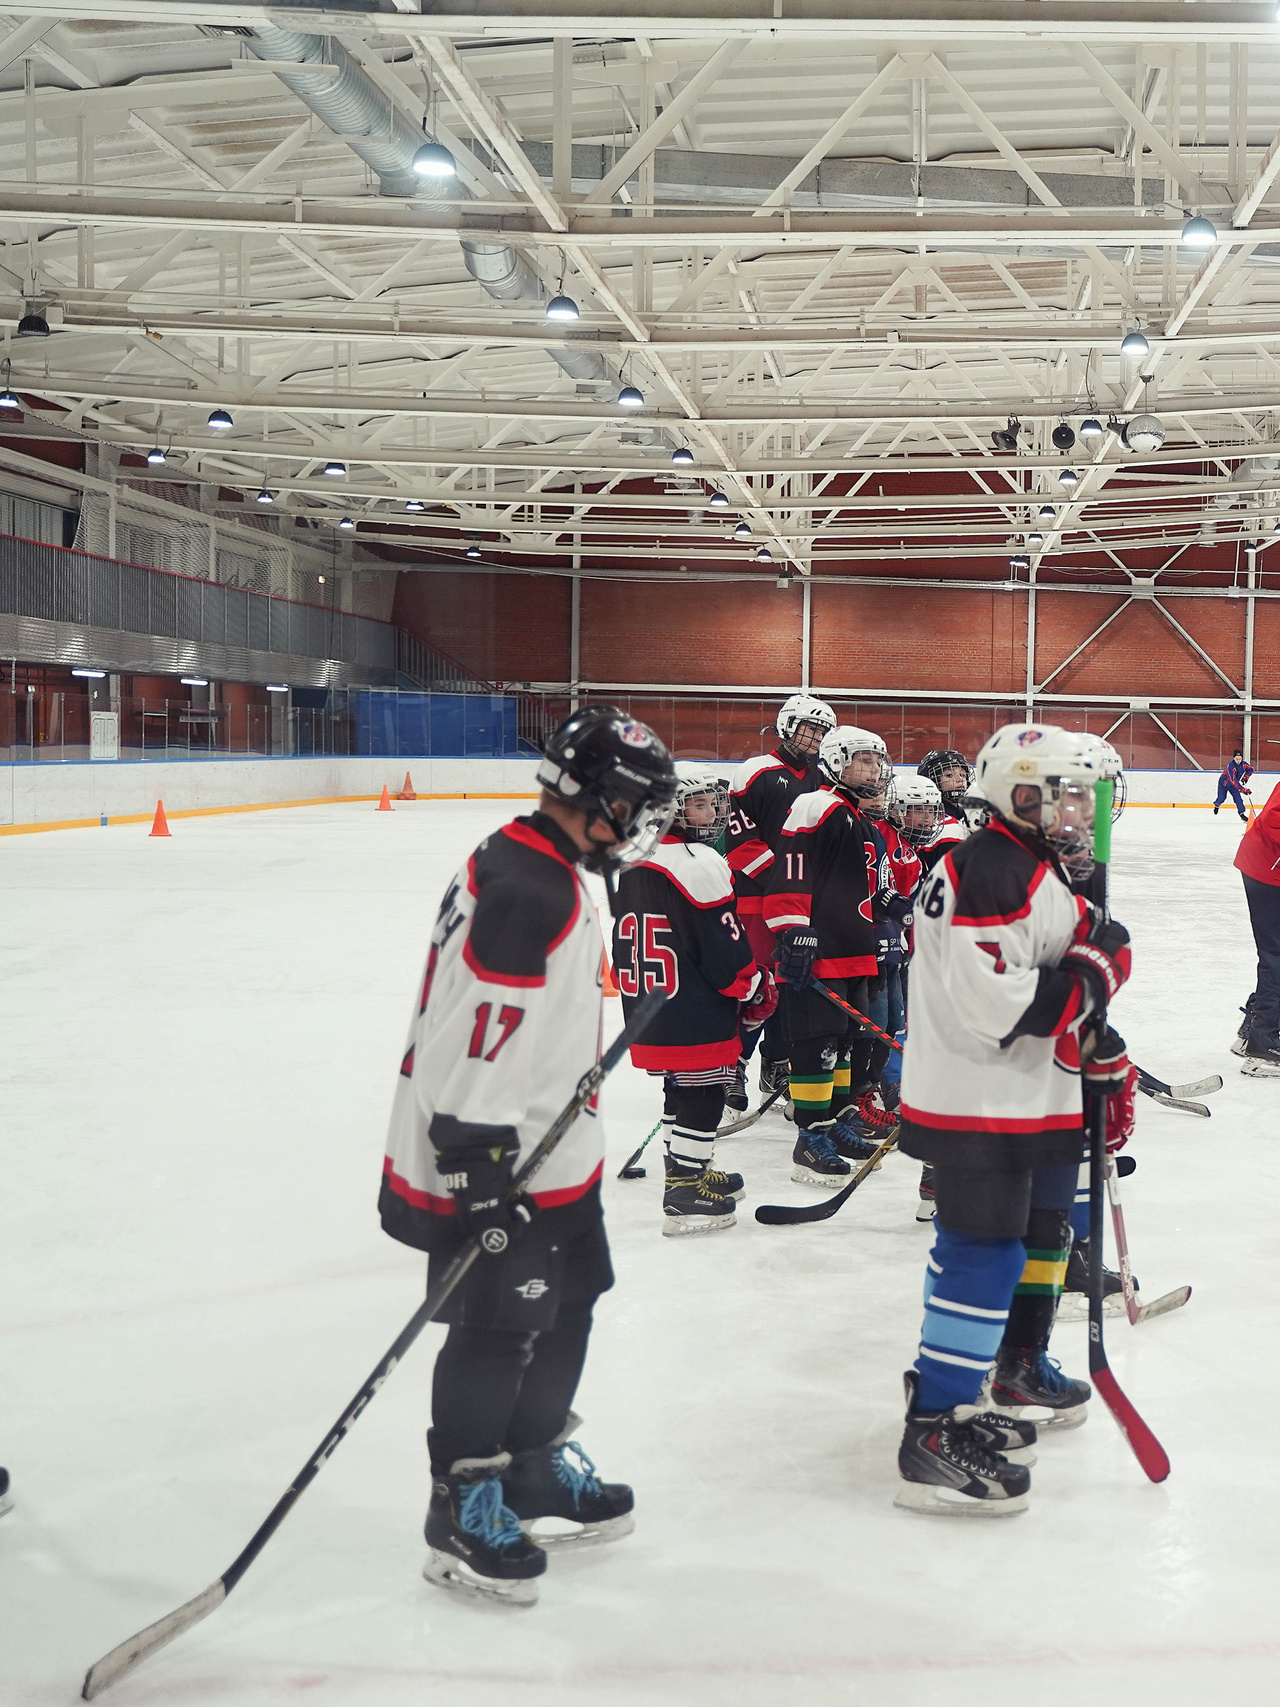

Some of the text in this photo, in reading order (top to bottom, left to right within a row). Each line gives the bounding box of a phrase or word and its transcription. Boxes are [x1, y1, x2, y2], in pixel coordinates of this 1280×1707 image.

[785, 852, 804, 881] 11
[720, 911, 746, 942] 3
[618, 912, 680, 1001] 35
[467, 1001, 526, 1063] 17
